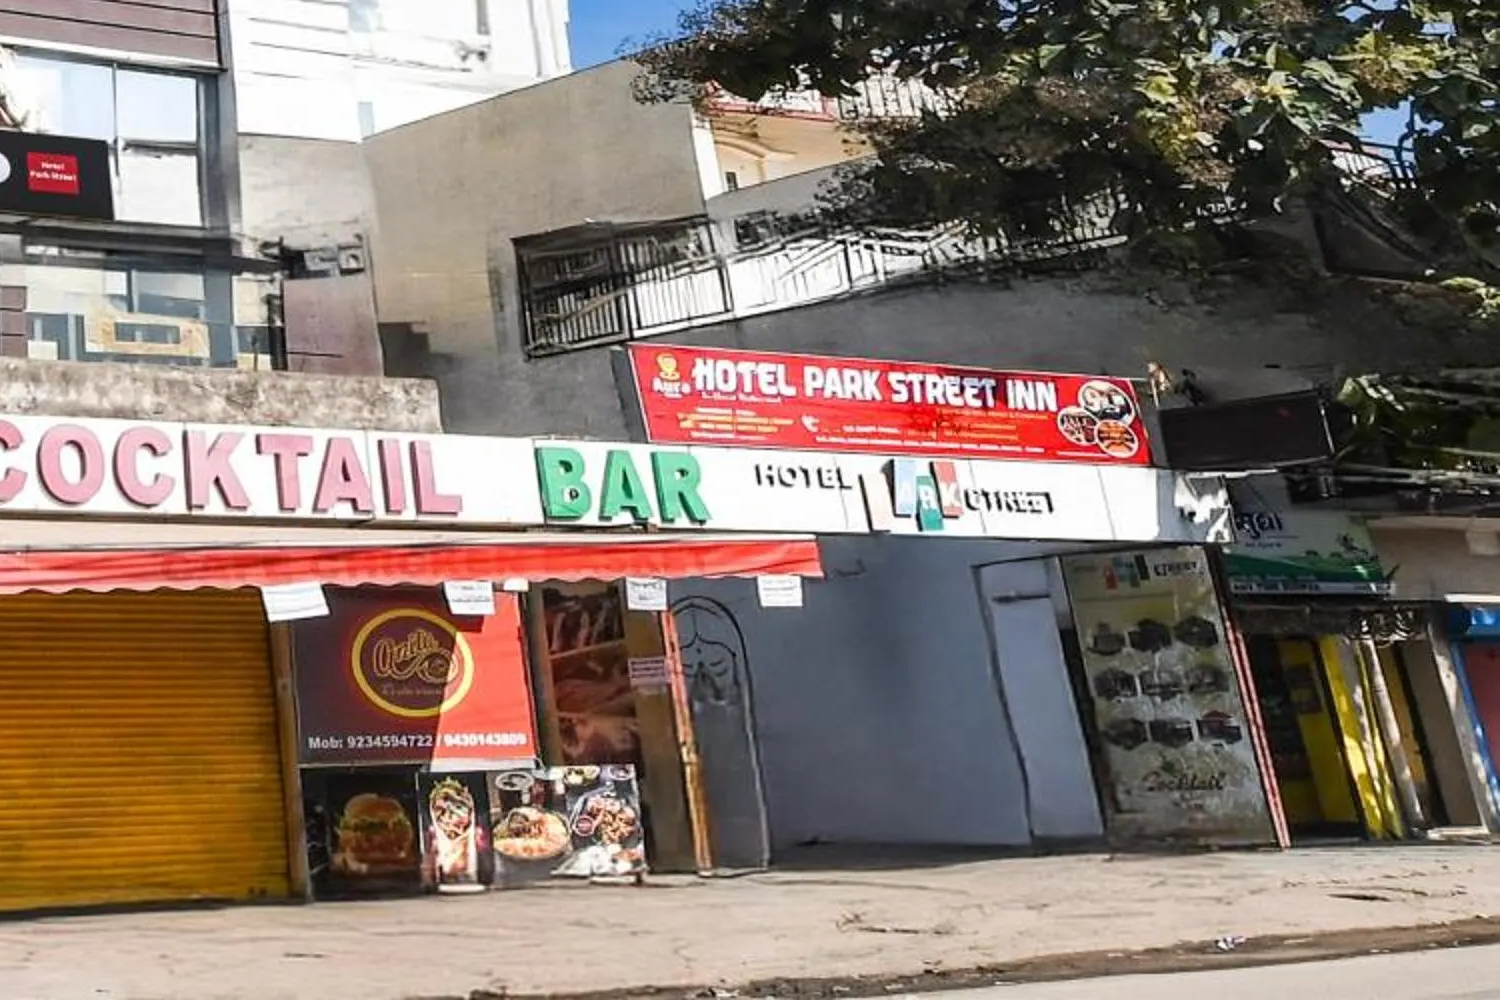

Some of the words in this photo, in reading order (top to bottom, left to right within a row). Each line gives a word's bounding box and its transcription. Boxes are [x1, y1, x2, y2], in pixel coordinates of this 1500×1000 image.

[692, 357, 797, 397] HOTEL
[803, 365, 882, 401] PARK
[887, 371, 997, 409] STREET
[1006, 379, 1058, 411] INN
[535, 446, 713, 523] BAR
[755, 463, 852, 490] HOTEL
[308, 736, 344, 749] Mob:
[347, 733, 433, 748] 9234594722
